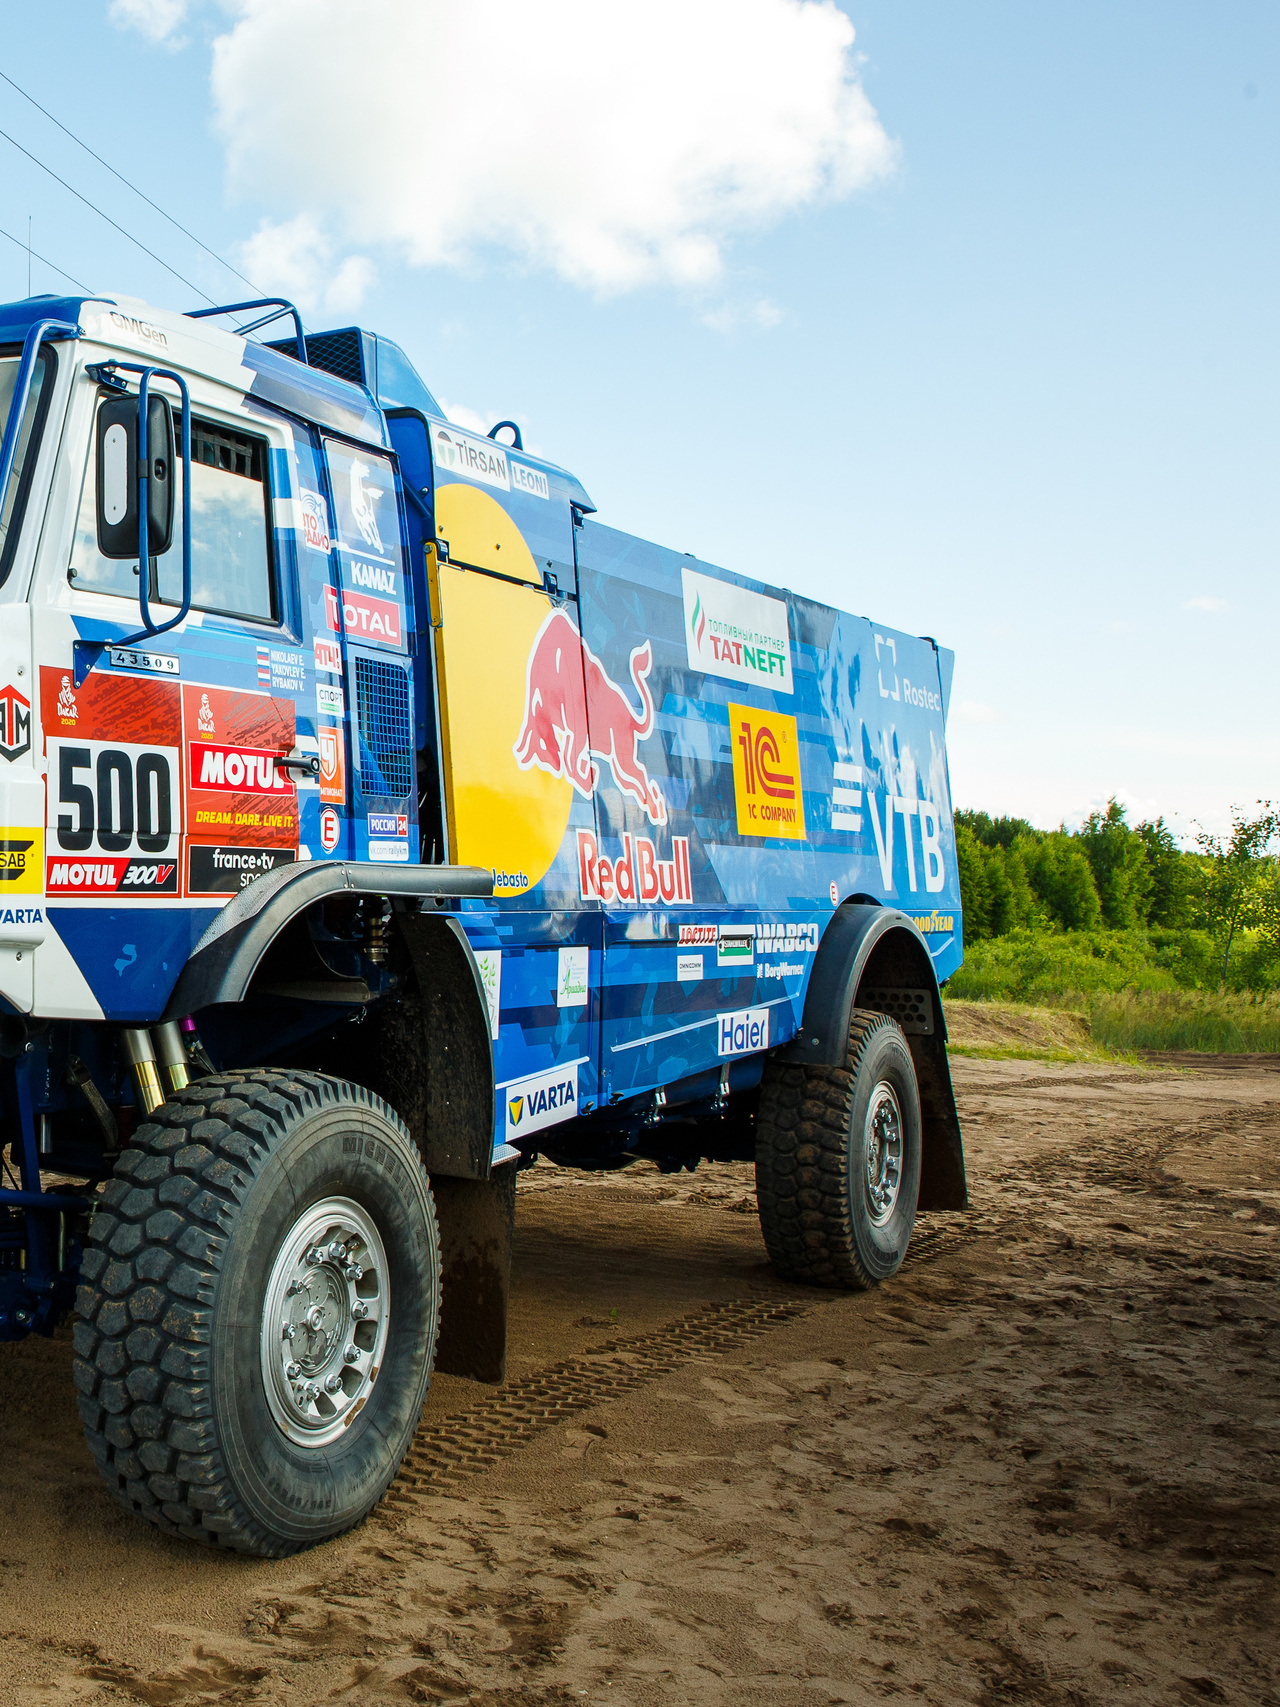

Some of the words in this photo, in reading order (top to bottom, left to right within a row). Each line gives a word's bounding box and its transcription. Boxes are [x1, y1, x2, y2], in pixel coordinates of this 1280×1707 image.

[110, 312, 168, 345] GMGen
[513, 466, 548, 495] LEONI
[351, 561, 396, 595] KAMAZ
[328, 593, 397, 638] TOTAL
[709, 619, 753, 643] ТОПЛИВНЫЙ
[754, 633, 785, 651] ПАРТНЕР
[271, 650, 298, 665] NIKOLAEV
[271, 663, 300, 678] YAKOVLEV
[709, 635, 786, 677] TATNEFT
[272, 676, 298, 691] RYBAKOV
[319, 689, 342, 703] СПОРТ
[903, 678, 941, 712] Rostec
[61, 718, 76, 726] 2020
[201, 732, 213, 740] 2020
[200, 750, 285, 788] MOTUL
[57, 746, 171, 853] 500
[320, 787, 343, 798] МПИОНАТ
[195, 811, 233, 824] DREAM.
[235, 813, 262, 826] DARE.
[263, 815, 282, 827] LIVE
[283, 816, 294, 827] IT.
[371, 819, 396, 832] РОССИЯ
[398, 820, 406, 831] 24
[760, 805, 796, 823] COMPANY
[867, 792, 945, 893] VTB
[49, 864, 117, 885] MOTUL
[123, 865, 175, 885] 300V
[577, 831, 636, 902] Red
[636, 838, 692, 904] Bull
[679, 927, 716, 945] LOCTITE
[757, 923, 819, 953] WABCO
[765, 962, 804, 980] BorgWarner
[721, 1013, 765, 1052] Haier
[527, 1079, 575, 1116] VARTA
